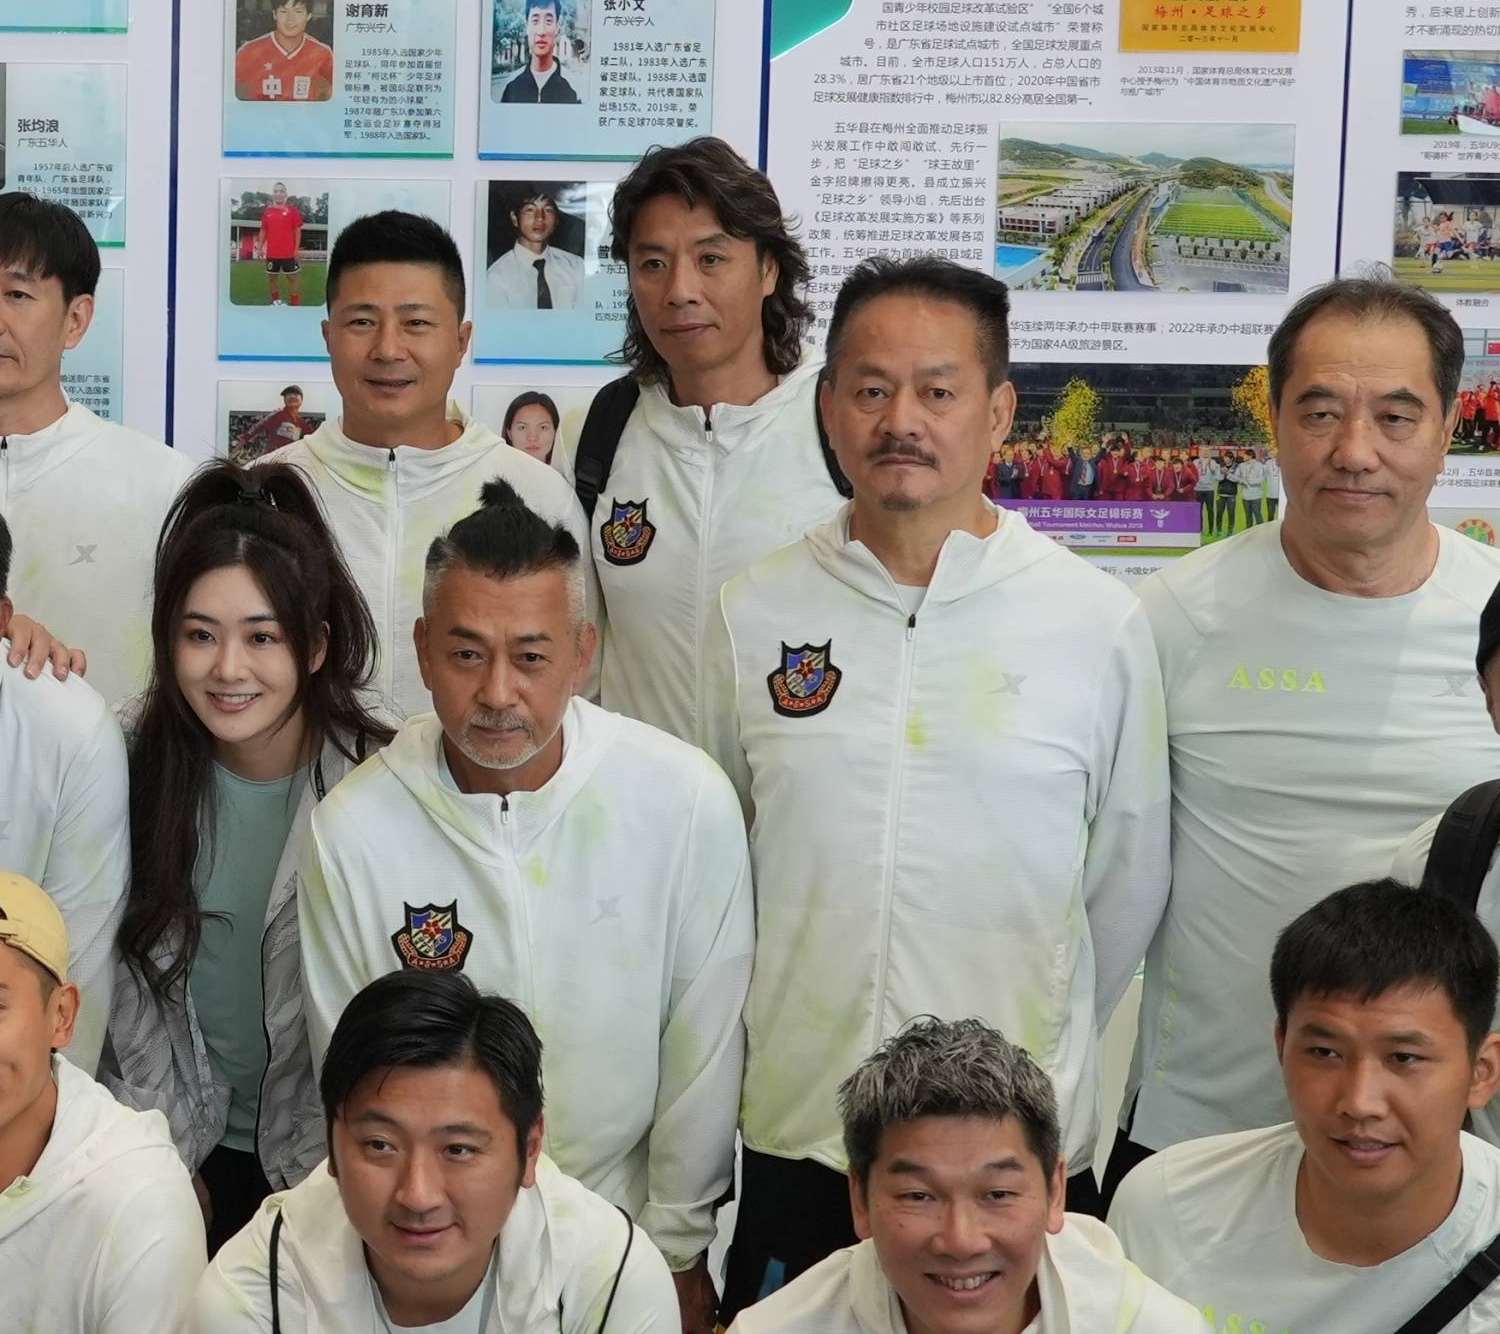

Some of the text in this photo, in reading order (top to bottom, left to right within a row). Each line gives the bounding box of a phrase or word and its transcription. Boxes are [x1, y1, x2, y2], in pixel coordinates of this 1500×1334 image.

[346, 3, 388, 18] 谢育新
[345, 22, 396, 33] 广东兴宁人
[603, 16, 655, 27] 广东兴宁人
[17, 118, 59, 133] 张均浪
[17, 138, 68, 148] 广东五华人
[1228, 666, 1326, 694] ASSA
